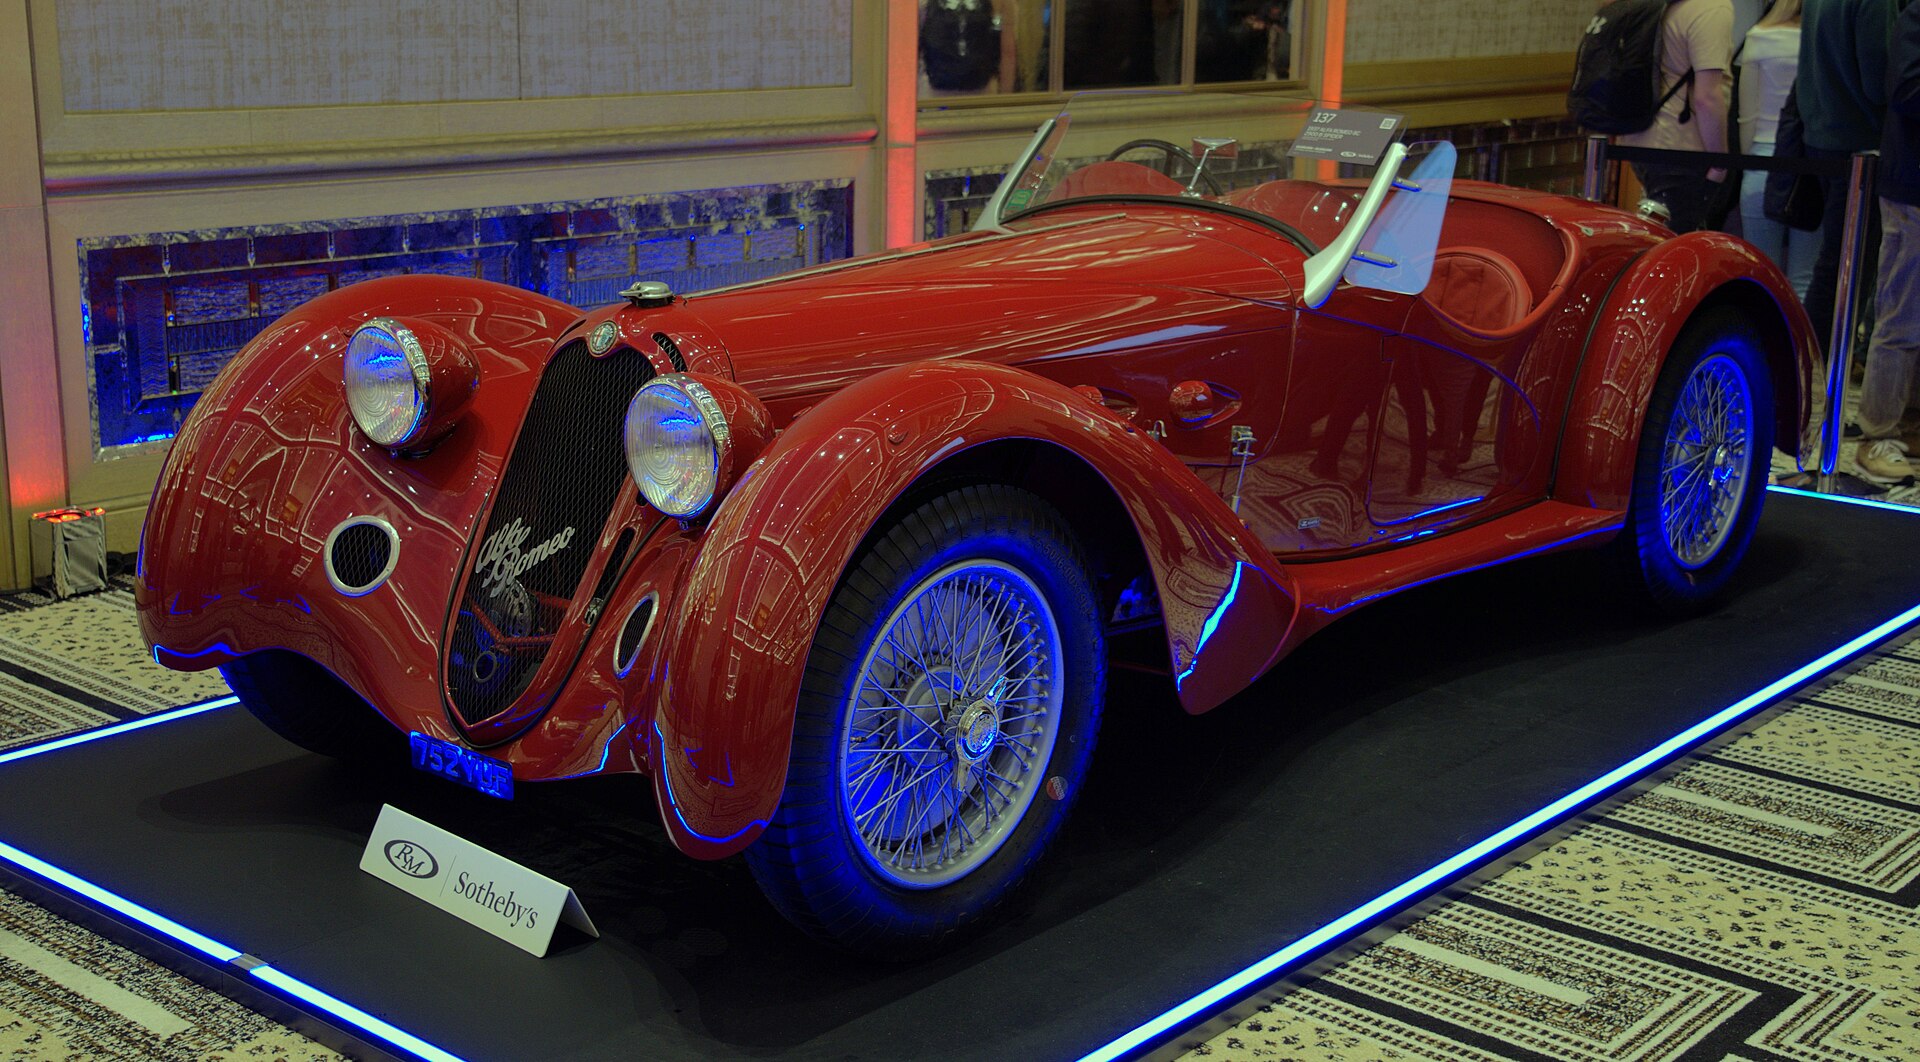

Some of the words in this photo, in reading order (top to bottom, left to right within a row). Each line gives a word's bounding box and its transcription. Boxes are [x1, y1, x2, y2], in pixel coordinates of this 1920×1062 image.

[1313, 112, 1337, 123] 137
[475, 517, 531, 573] Alfa
[482, 526, 575, 598] Romeo
[394, 843, 424, 875] RM
[453, 871, 539, 929] Sotheby's
